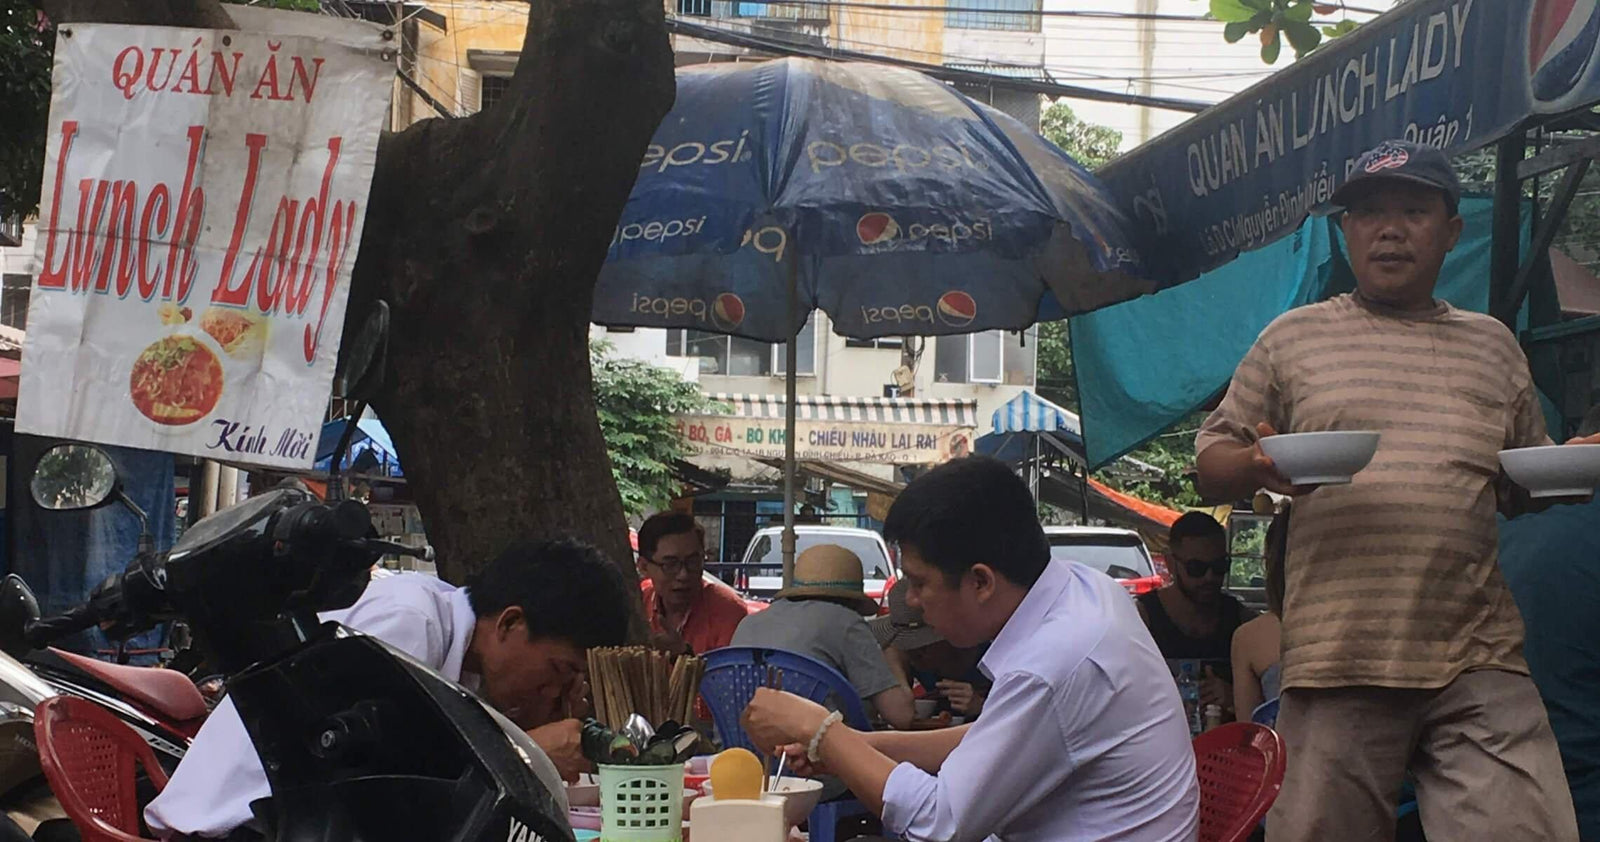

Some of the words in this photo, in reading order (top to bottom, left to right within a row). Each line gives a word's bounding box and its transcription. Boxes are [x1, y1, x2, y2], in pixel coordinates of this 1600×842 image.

[1384, 0, 1473, 101] LADY
[112, 37, 244, 100] QUÁN
[250, 40, 325, 103] ĂN
[1464, 103, 1473, 141] 1
[641, 130, 748, 173] epsi
[806, 140, 977, 174] pepsi
[38, 121, 205, 303] Lunch
[211, 133, 356, 364] Lady
[620, 215, 707, 244] pepsi
[908, 216, 993, 249] pepsi
[205, 419, 268, 455] Kính
[714, 423, 733, 443] GÀ
[746, 423, 764, 444] BÒ
[768, 427, 787, 445] KH
[891, 432, 911, 449] LAI
[916, 433, 937, 450] RAI
